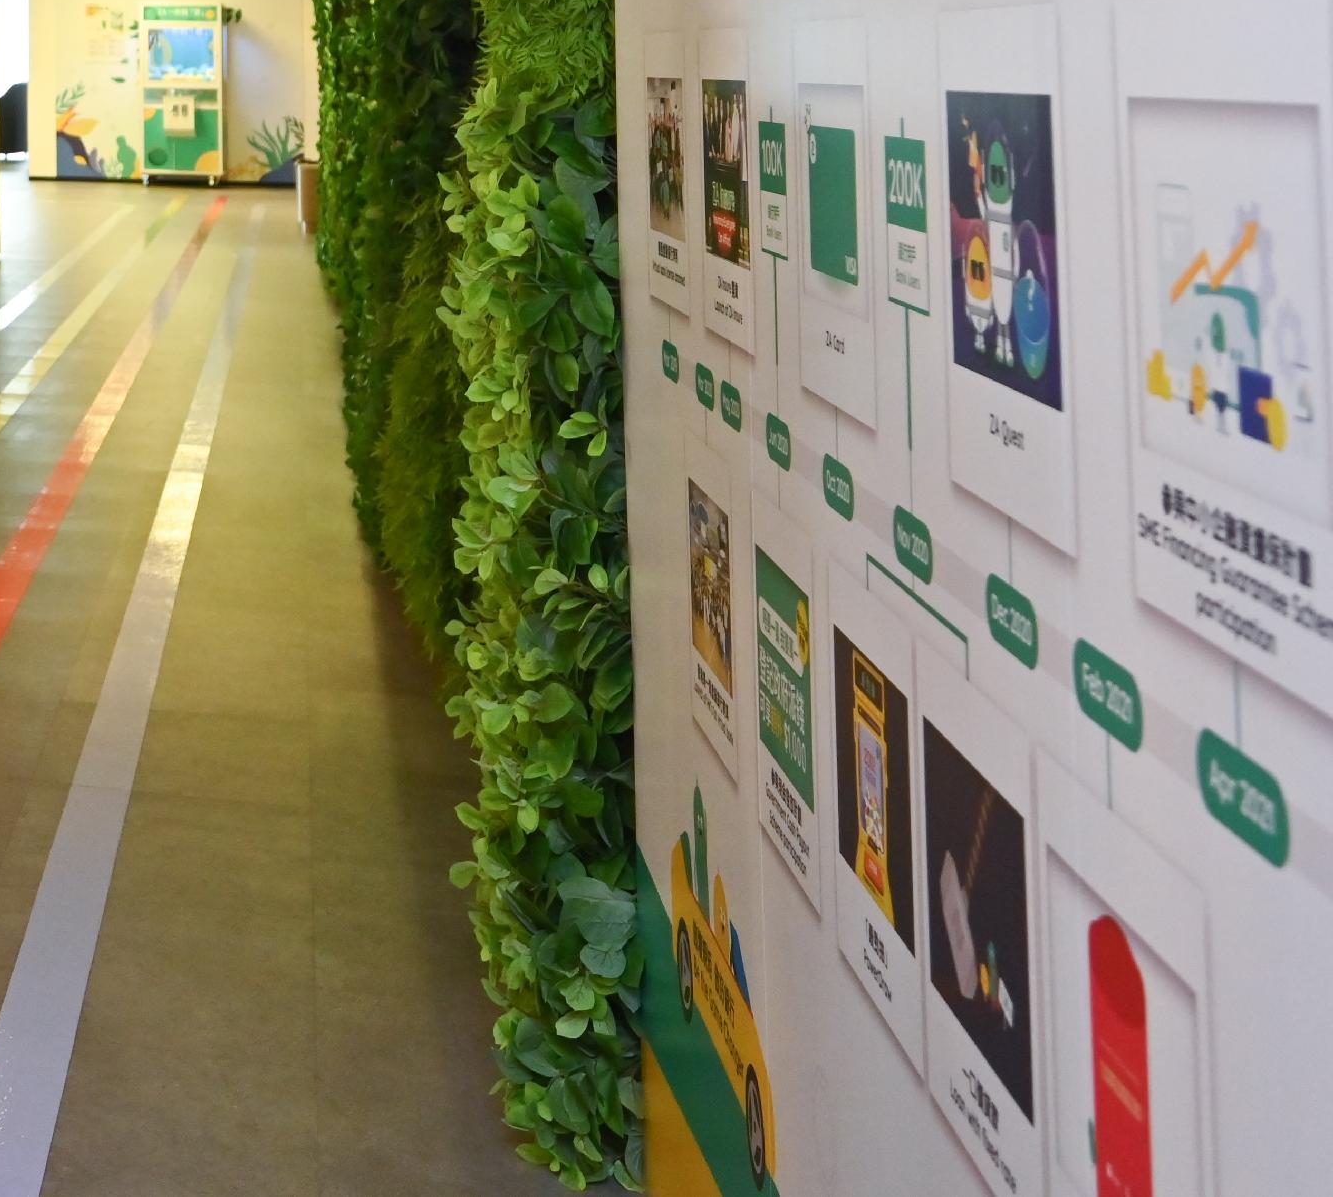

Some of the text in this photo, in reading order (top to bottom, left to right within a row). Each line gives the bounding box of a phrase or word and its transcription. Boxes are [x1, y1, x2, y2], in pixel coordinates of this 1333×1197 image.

[762, 140, 783, 176] 100K
[888, 157, 923, 209] 200K
[826, 331, 845, 354] ZA Card
[990, 413, 1024, 451] ZA Quest
[911, 533, 928, 565] 2020
[991, 594, 1032, 646] Dec 2020
[1196, 592, 1277, 654] participation
[1082, 661, 1105, 703] Feb
